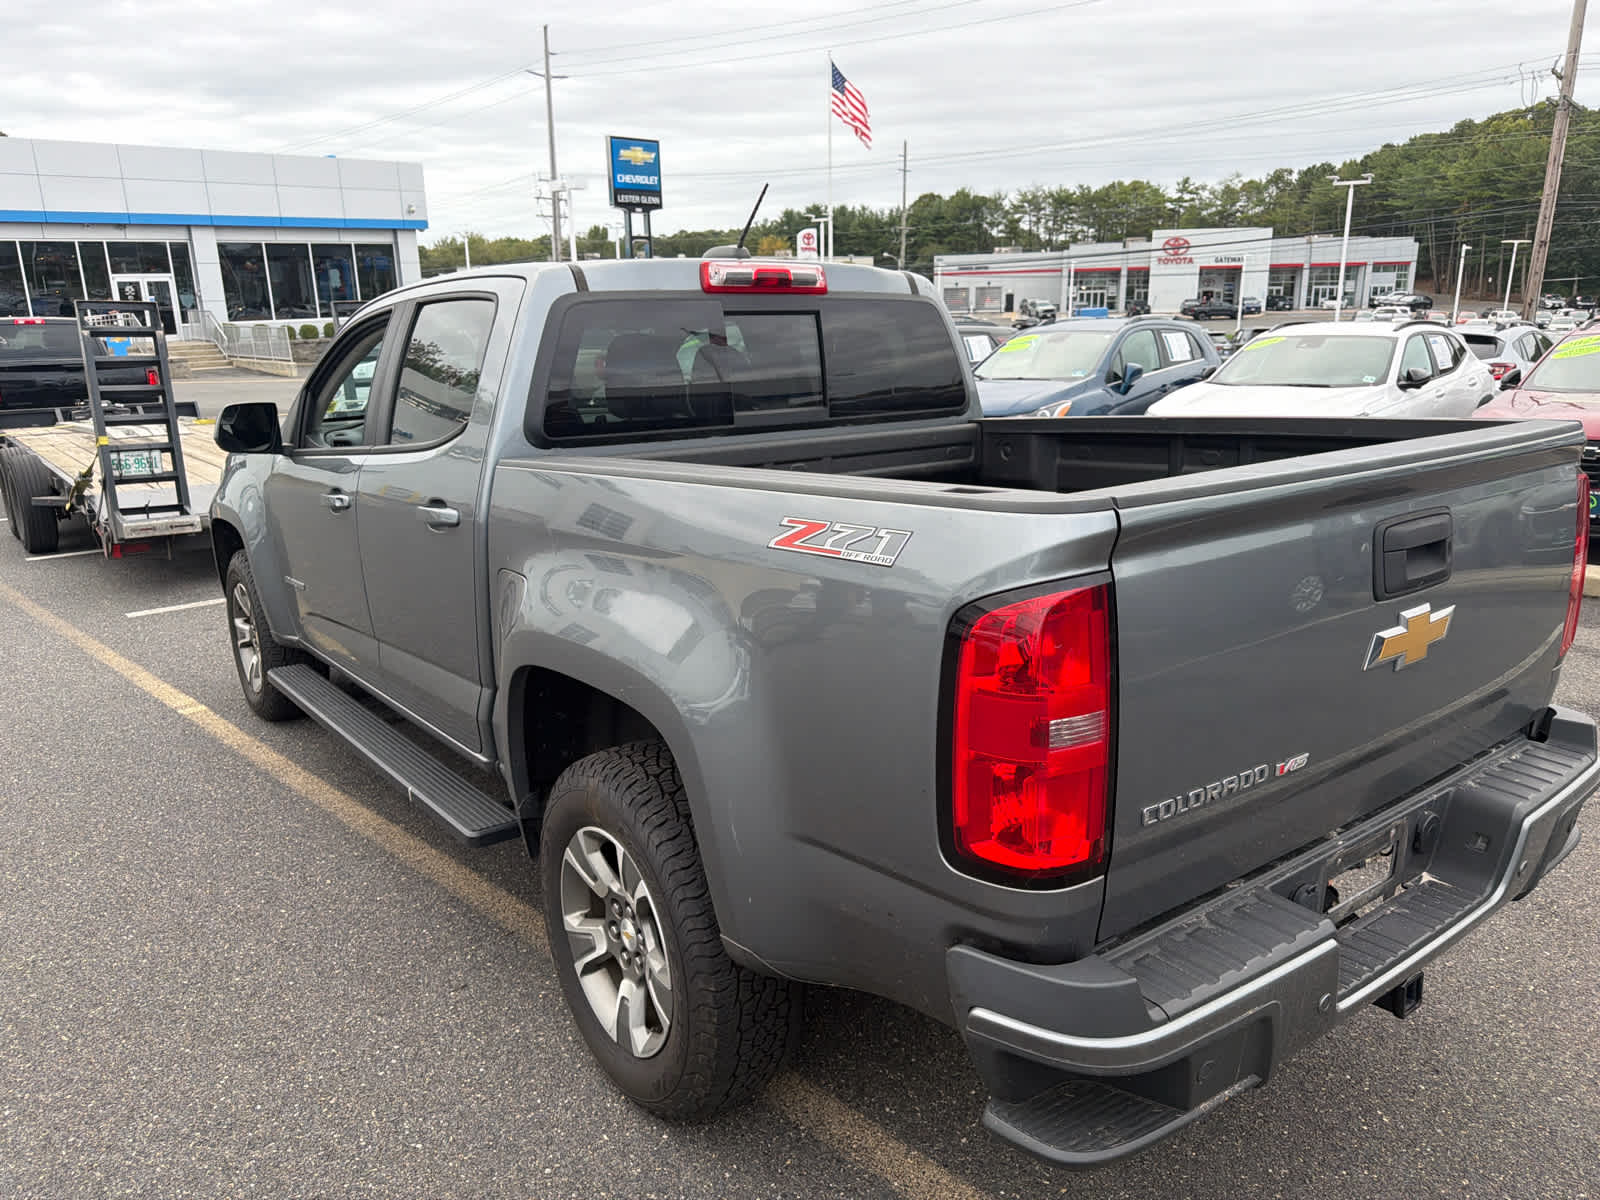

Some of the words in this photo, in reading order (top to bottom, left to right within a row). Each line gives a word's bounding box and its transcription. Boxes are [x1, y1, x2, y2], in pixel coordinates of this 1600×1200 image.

[617, 174, 658, 185] CHEVROLET
[617, 194, 641, 203] LESTER
[1157, 257, 1194, 265] TOYOTA
[767, 516, 913, 567] Z71
[842, 551, 859, 561] OFF
[863, 553, 893, 564] ROAD
[1141, 764, 1269, 826] COLORADO
